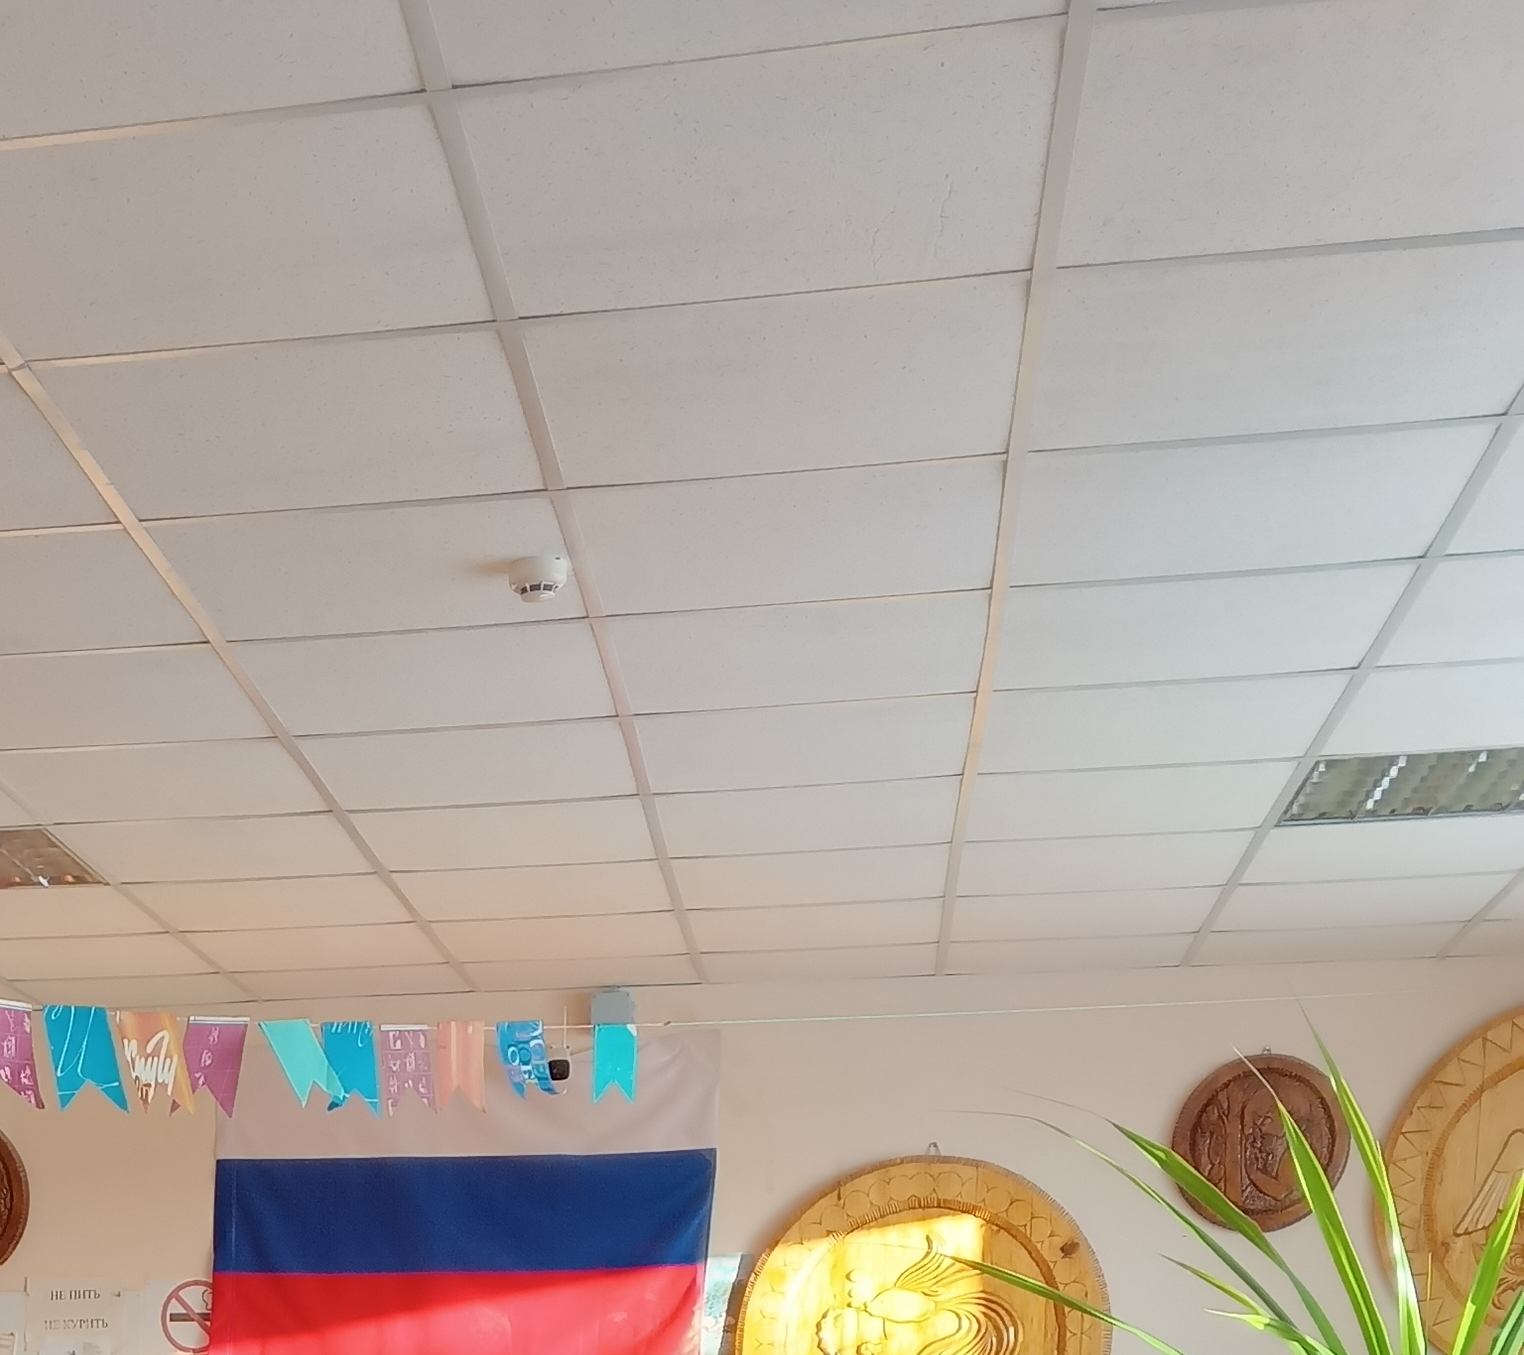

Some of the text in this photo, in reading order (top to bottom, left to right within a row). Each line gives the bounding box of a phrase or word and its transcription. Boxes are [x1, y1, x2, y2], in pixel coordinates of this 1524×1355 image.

[50, 1289, 100, 1301] НЕ ПИТЬ
[63, 1318, 108, 1330] КУРИТЬ
